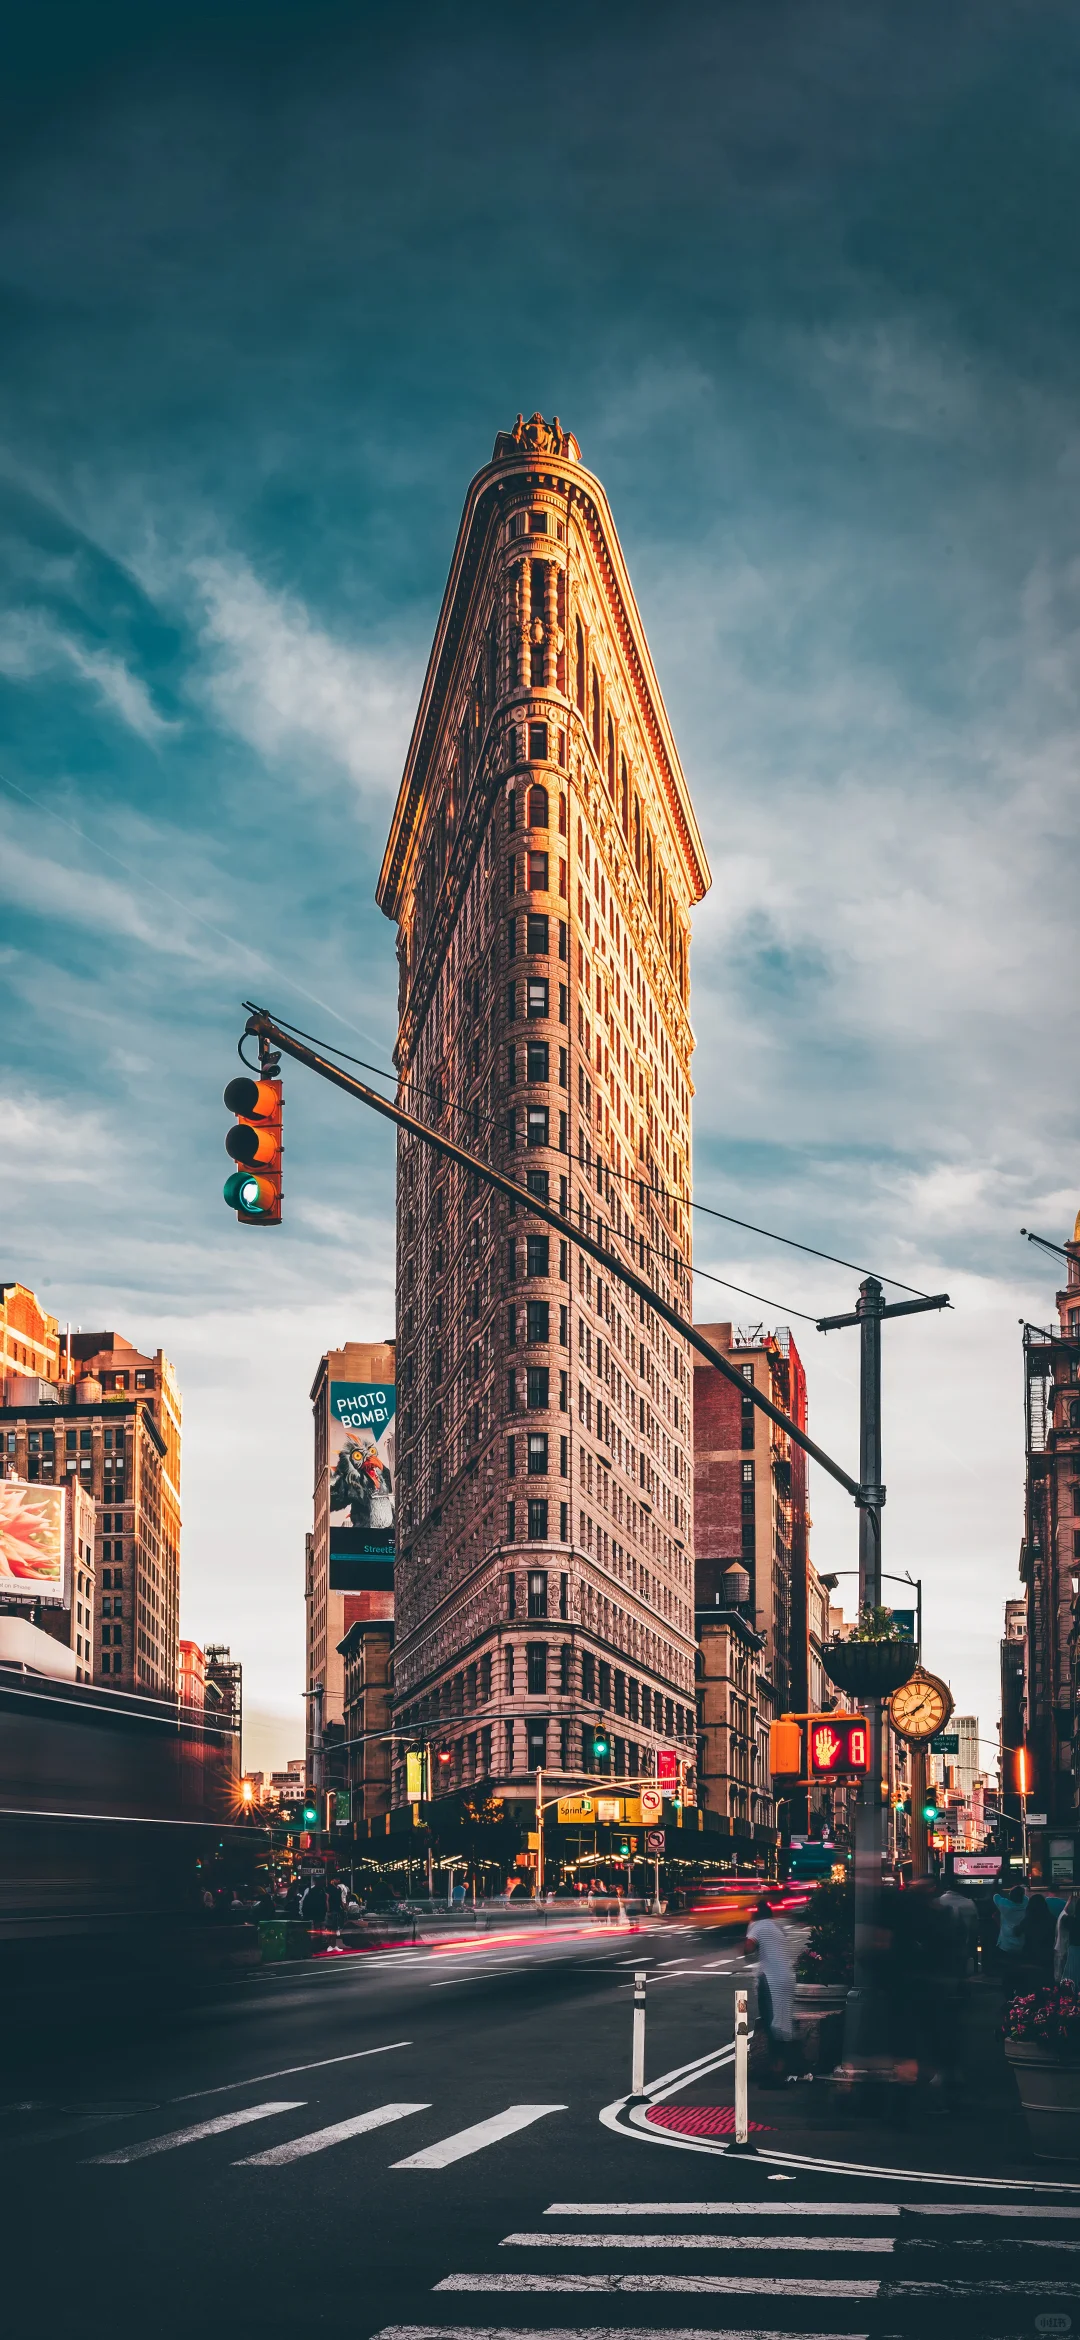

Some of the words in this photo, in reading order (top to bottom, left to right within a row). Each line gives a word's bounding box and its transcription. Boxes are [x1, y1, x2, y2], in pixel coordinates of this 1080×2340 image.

[337, 1391, 386, 1412] PHOTO
[340, 1407, 389, 1428] BOMB!
[560, 1807, 583, 1816] Sprint
